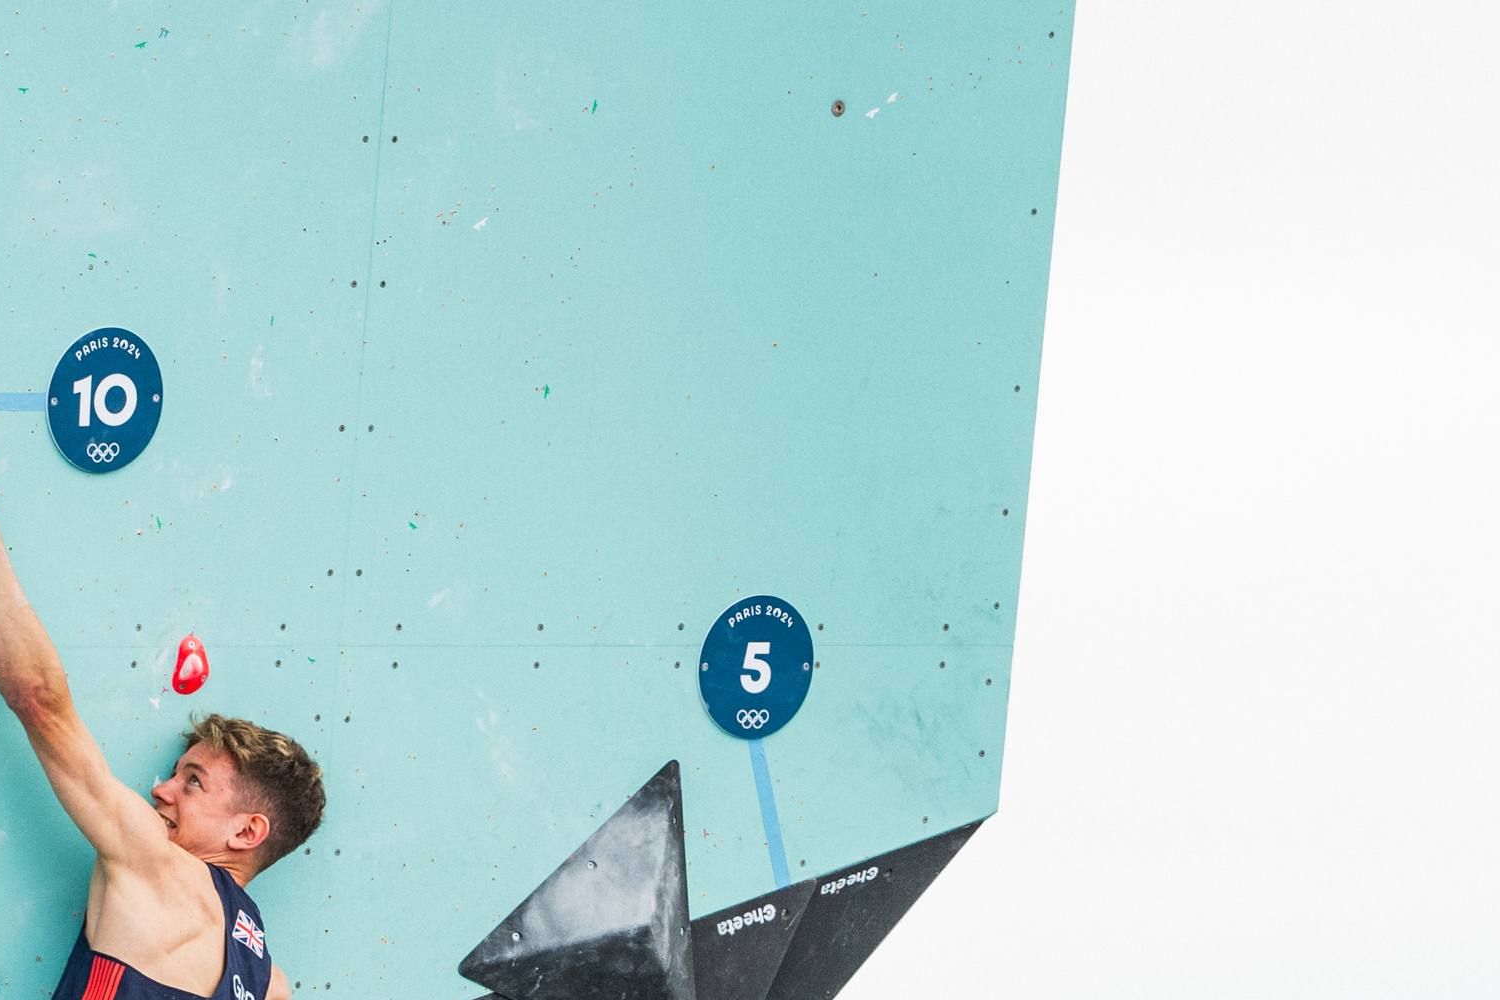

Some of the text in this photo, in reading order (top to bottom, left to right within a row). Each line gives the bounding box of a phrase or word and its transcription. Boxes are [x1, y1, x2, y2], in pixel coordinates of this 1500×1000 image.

[113, 337, 141, 360] 2024
[73, 373, 138, 427] 10
[765, 605, 794, 628] 2024
[740, 642, 772, 694] 5
[821, 866, 879, 895] Cheeta
[717, 904, 777, 936] Cheeta
